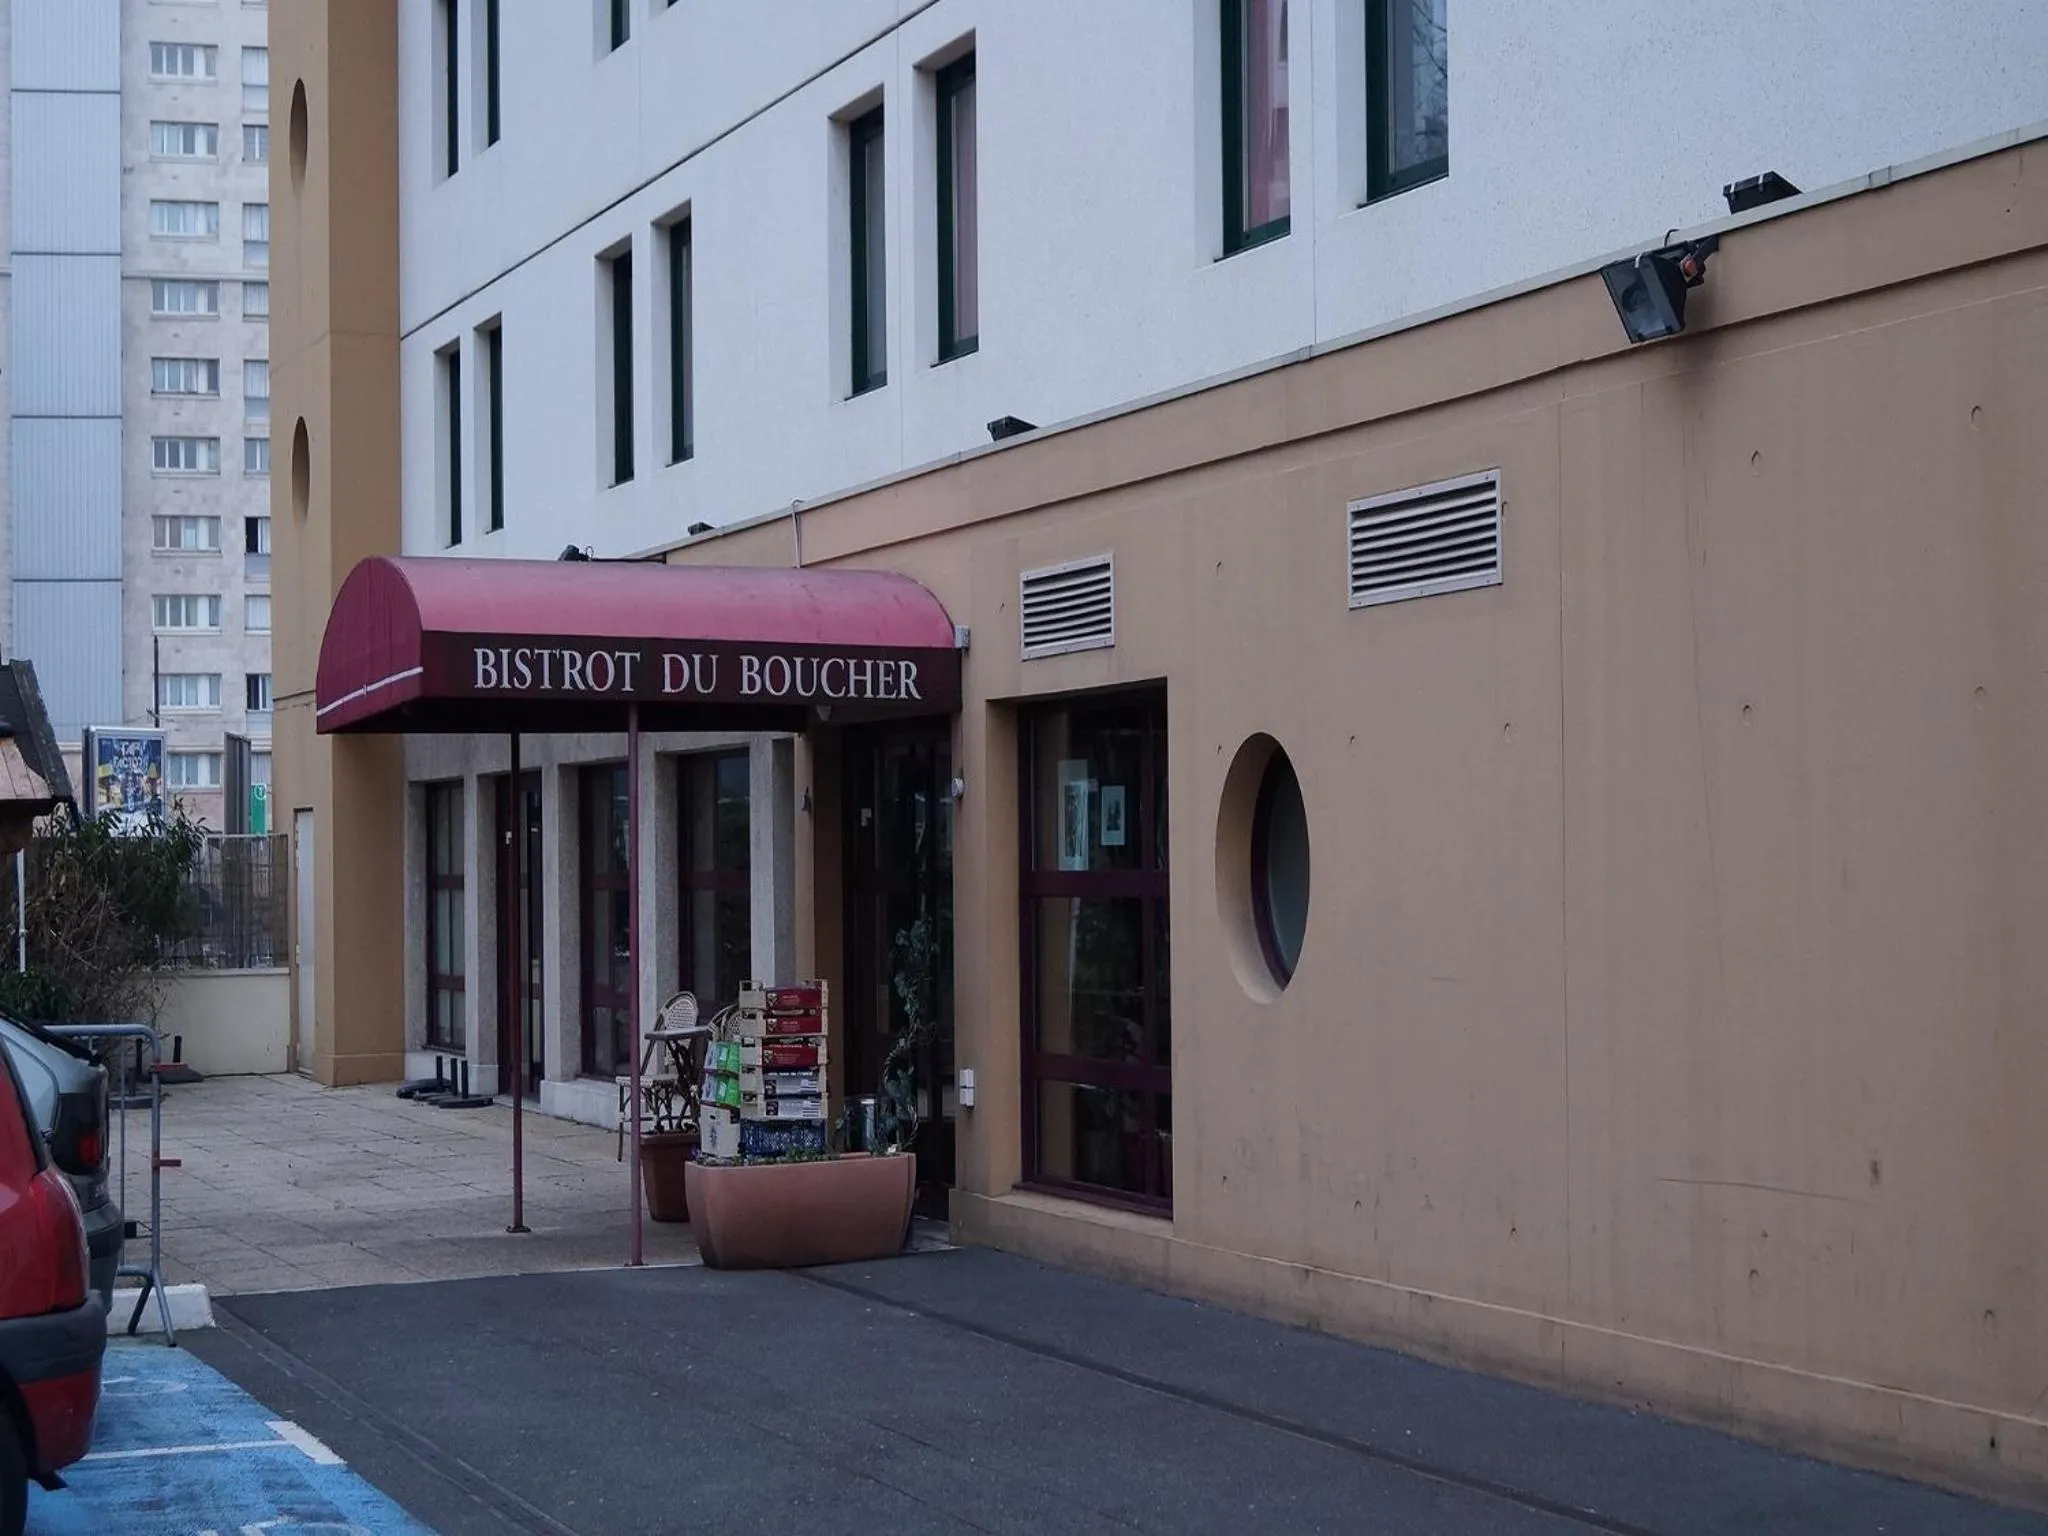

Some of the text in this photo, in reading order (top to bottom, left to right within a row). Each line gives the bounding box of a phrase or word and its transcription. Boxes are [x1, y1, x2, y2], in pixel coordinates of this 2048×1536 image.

[473, 647, 922, 700] BISTROT DU BOUCHER
